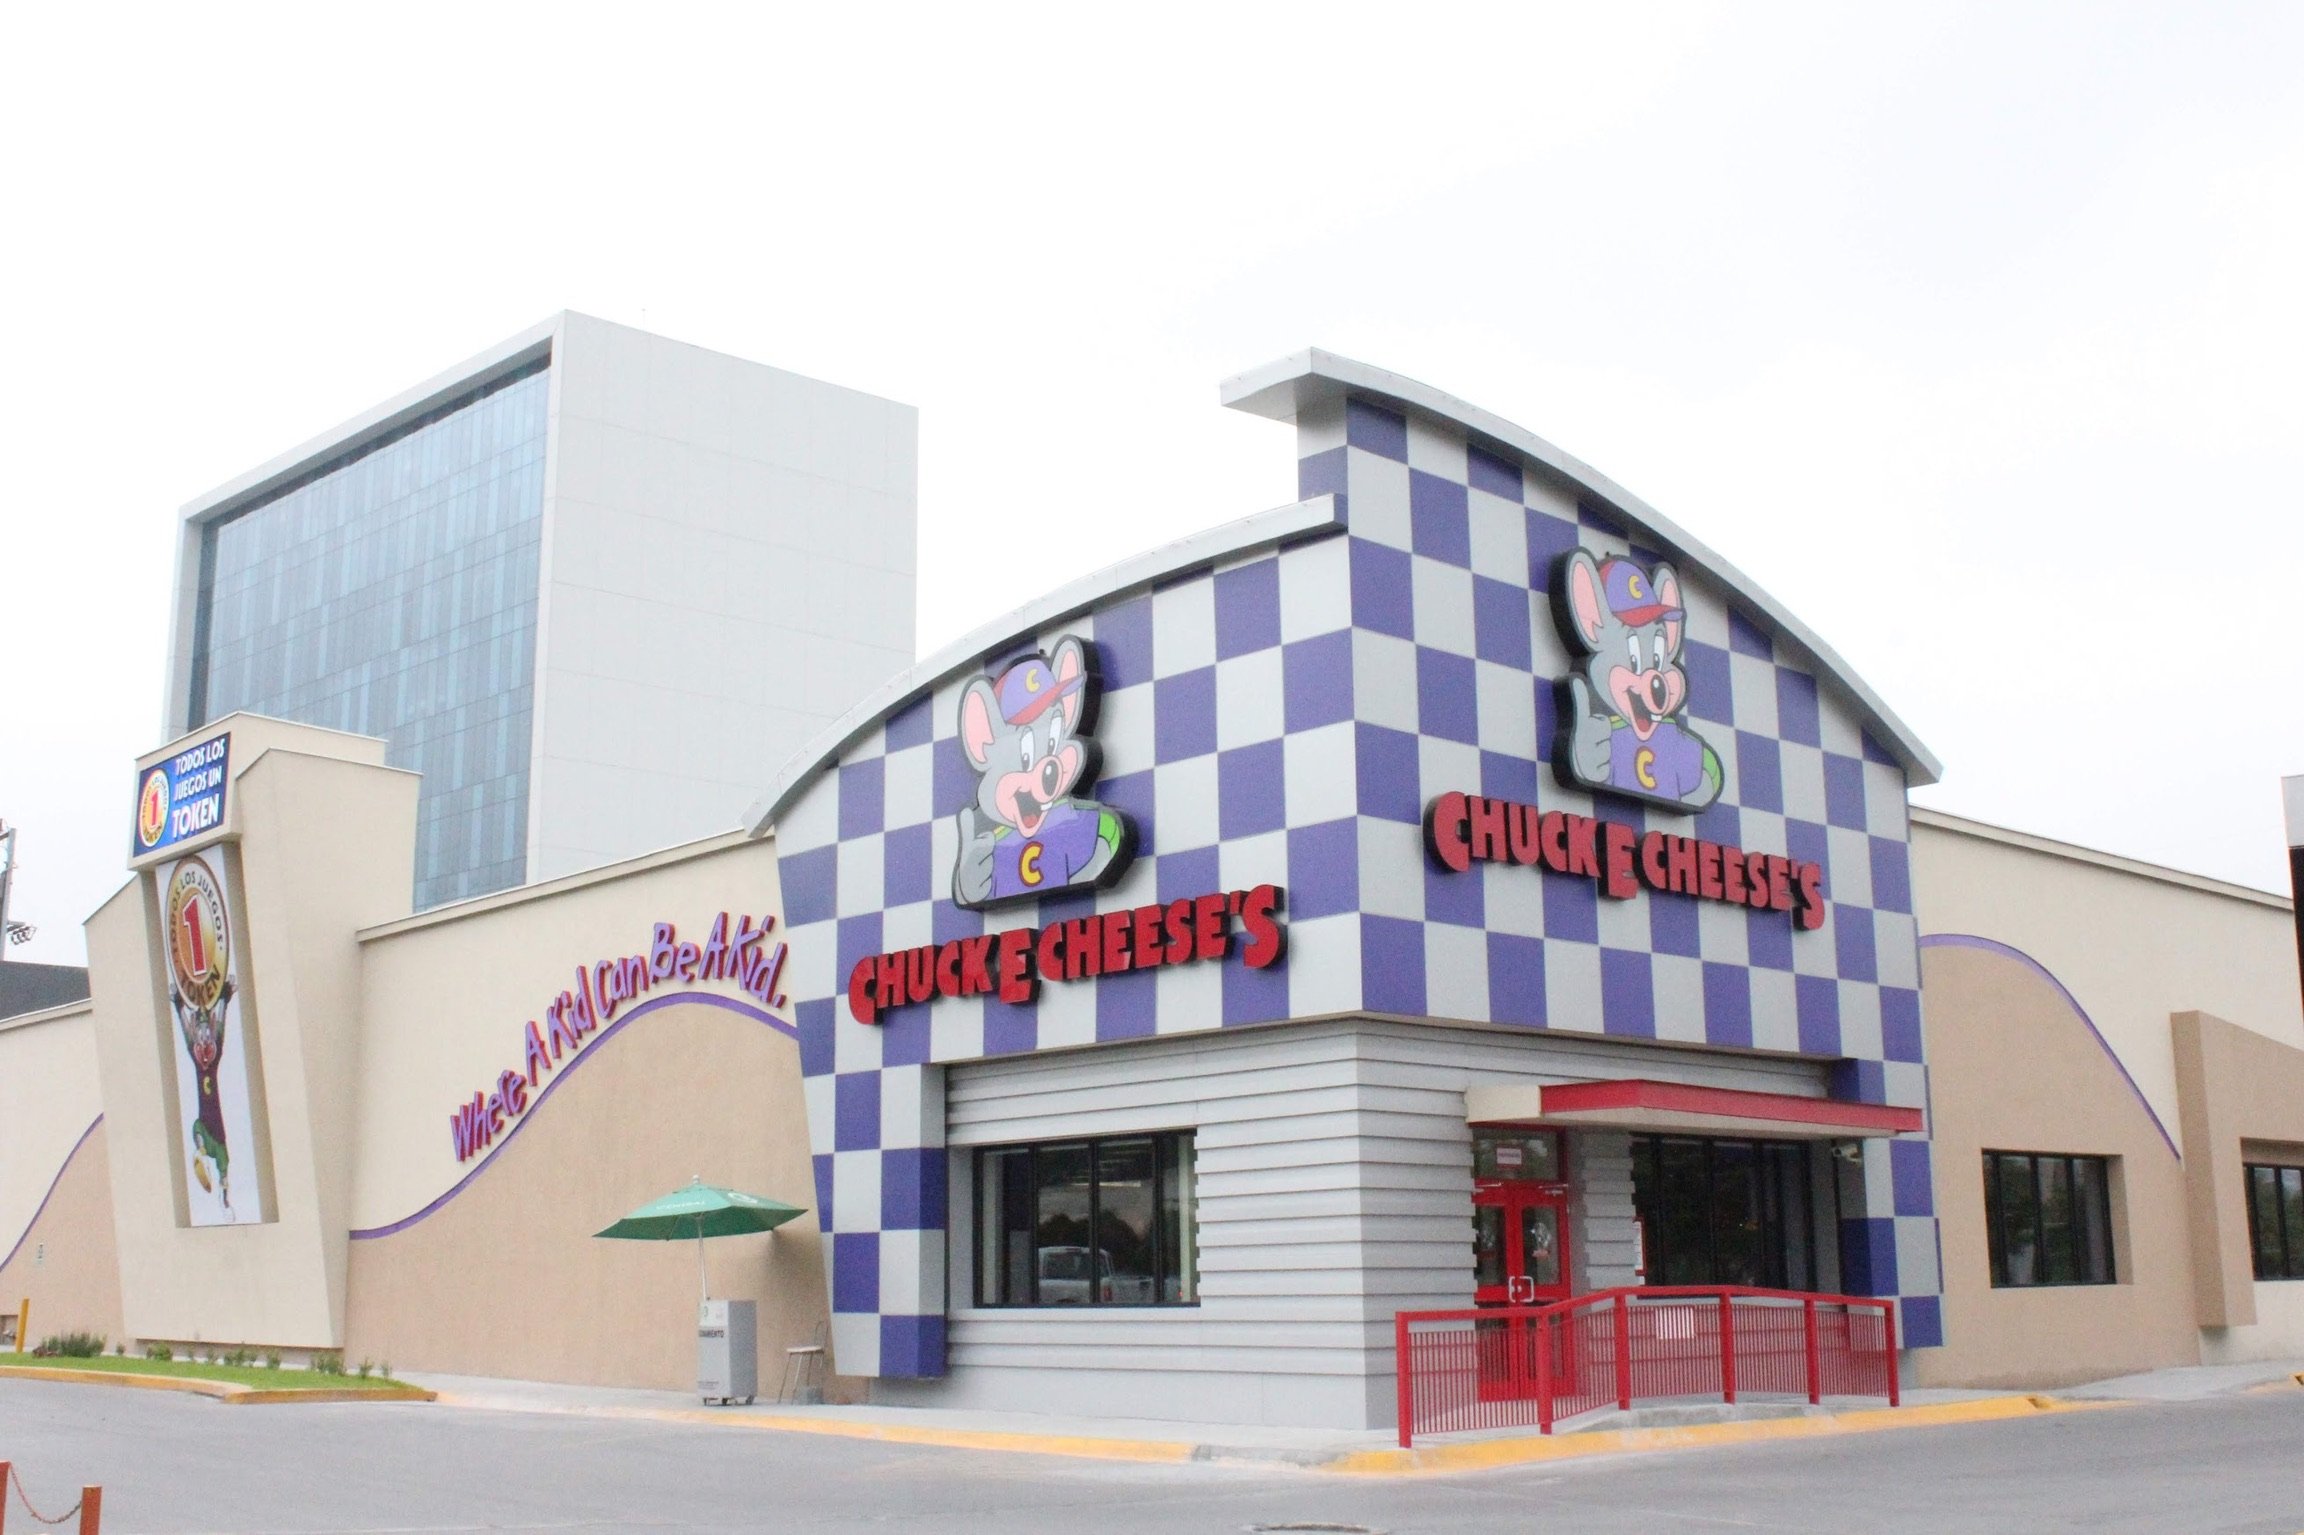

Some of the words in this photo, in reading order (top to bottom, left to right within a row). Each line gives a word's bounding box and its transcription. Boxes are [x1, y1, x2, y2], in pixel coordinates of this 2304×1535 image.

[175, 747, 205, 776] TODOS
[206, 738, 225, 763] LOS
[1634, 746, 1657, 789] C
[174, 773, 207, 801] JUEGOS
[208, 766, 222, 788] UN
[172, 793, 220, 838] TOKEN
[180, 871, 196, 889] LOS
[1018, 841, 1044, 887] C
[1426, 791, 1599, 878] CHUCK
[1601, 821, 1638, 900] E
[1640, 830, 1825, 930] CHEESE'S
[183, 895, 206, 975] 1
[848, 934, 998, 1025] CHUCK
[999, 927, 1042, 1005] E
[1037, 884, 1288, 982] CHEESE'S
[181, 963, 221, 1006] TOKEN
[450, 1069, 527, 1162] Where
[524, 1020, 552, 1087] A
[547, 965, 597, 1059] Kid
[593, 955, 649, 1020] Can
[650, 922, 701, 984] Be
[698, 911, 729, 981] A
